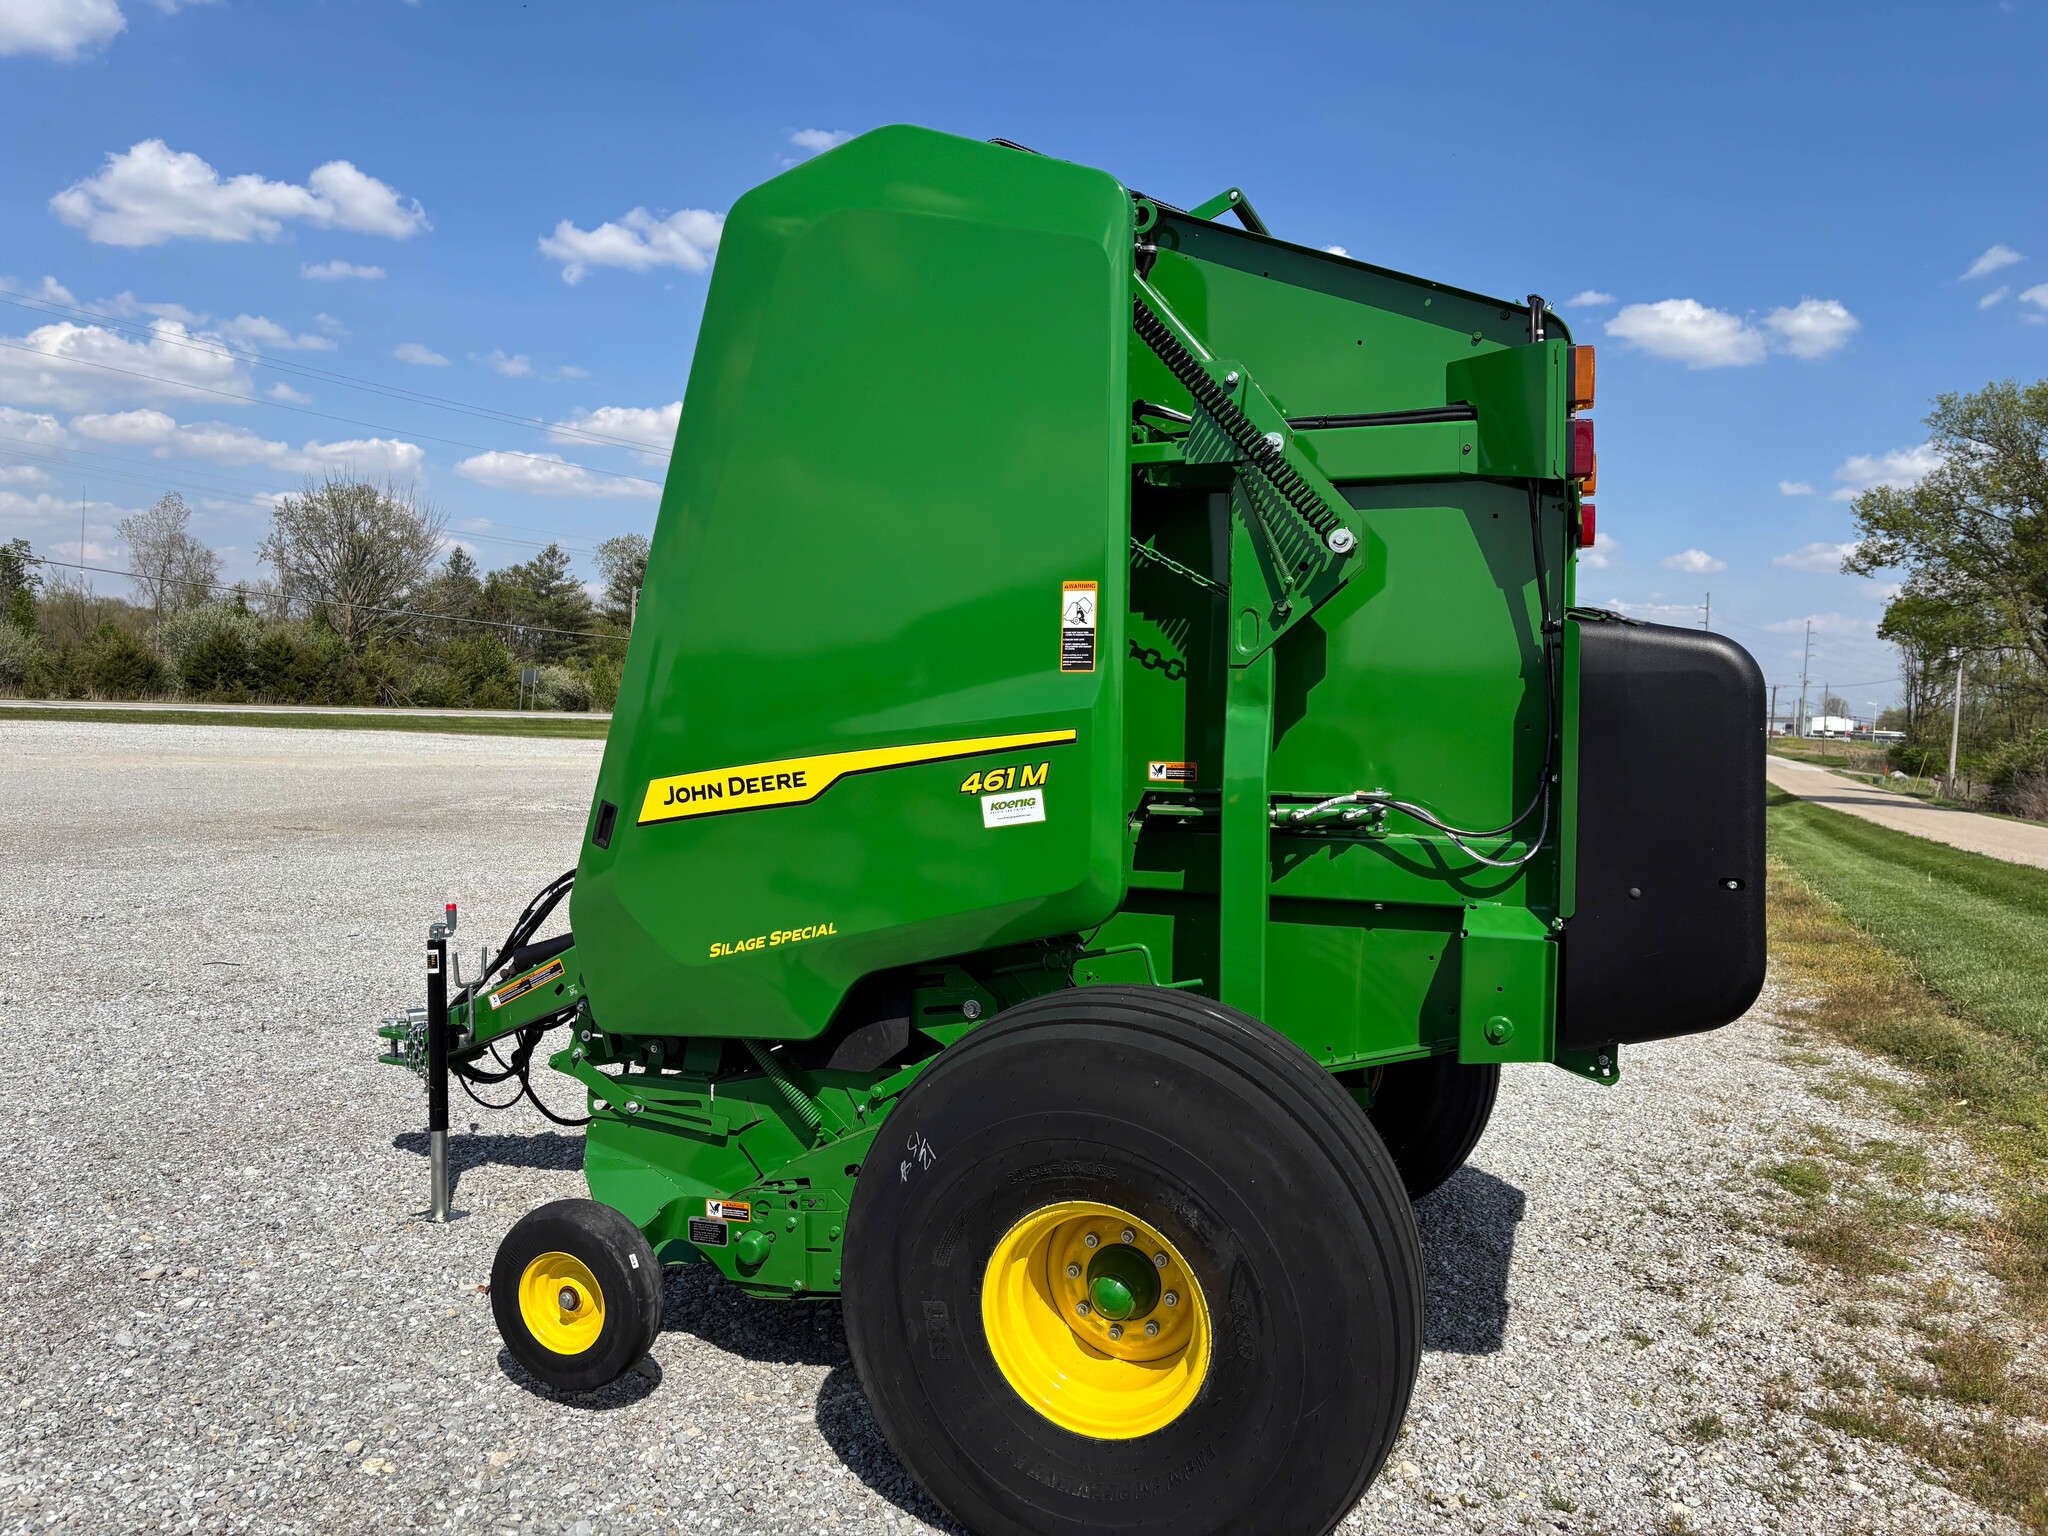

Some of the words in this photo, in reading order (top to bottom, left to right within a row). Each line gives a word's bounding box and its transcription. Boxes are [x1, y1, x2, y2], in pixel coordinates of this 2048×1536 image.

[663, 780, 723, 806] JOHN
[728, 770, 807, 797] DEERE
[959, 766, 1017, 796] 461
[709, 935, 766, 959] SILAGE
[769, 922, 837, 947] SPECIAL
